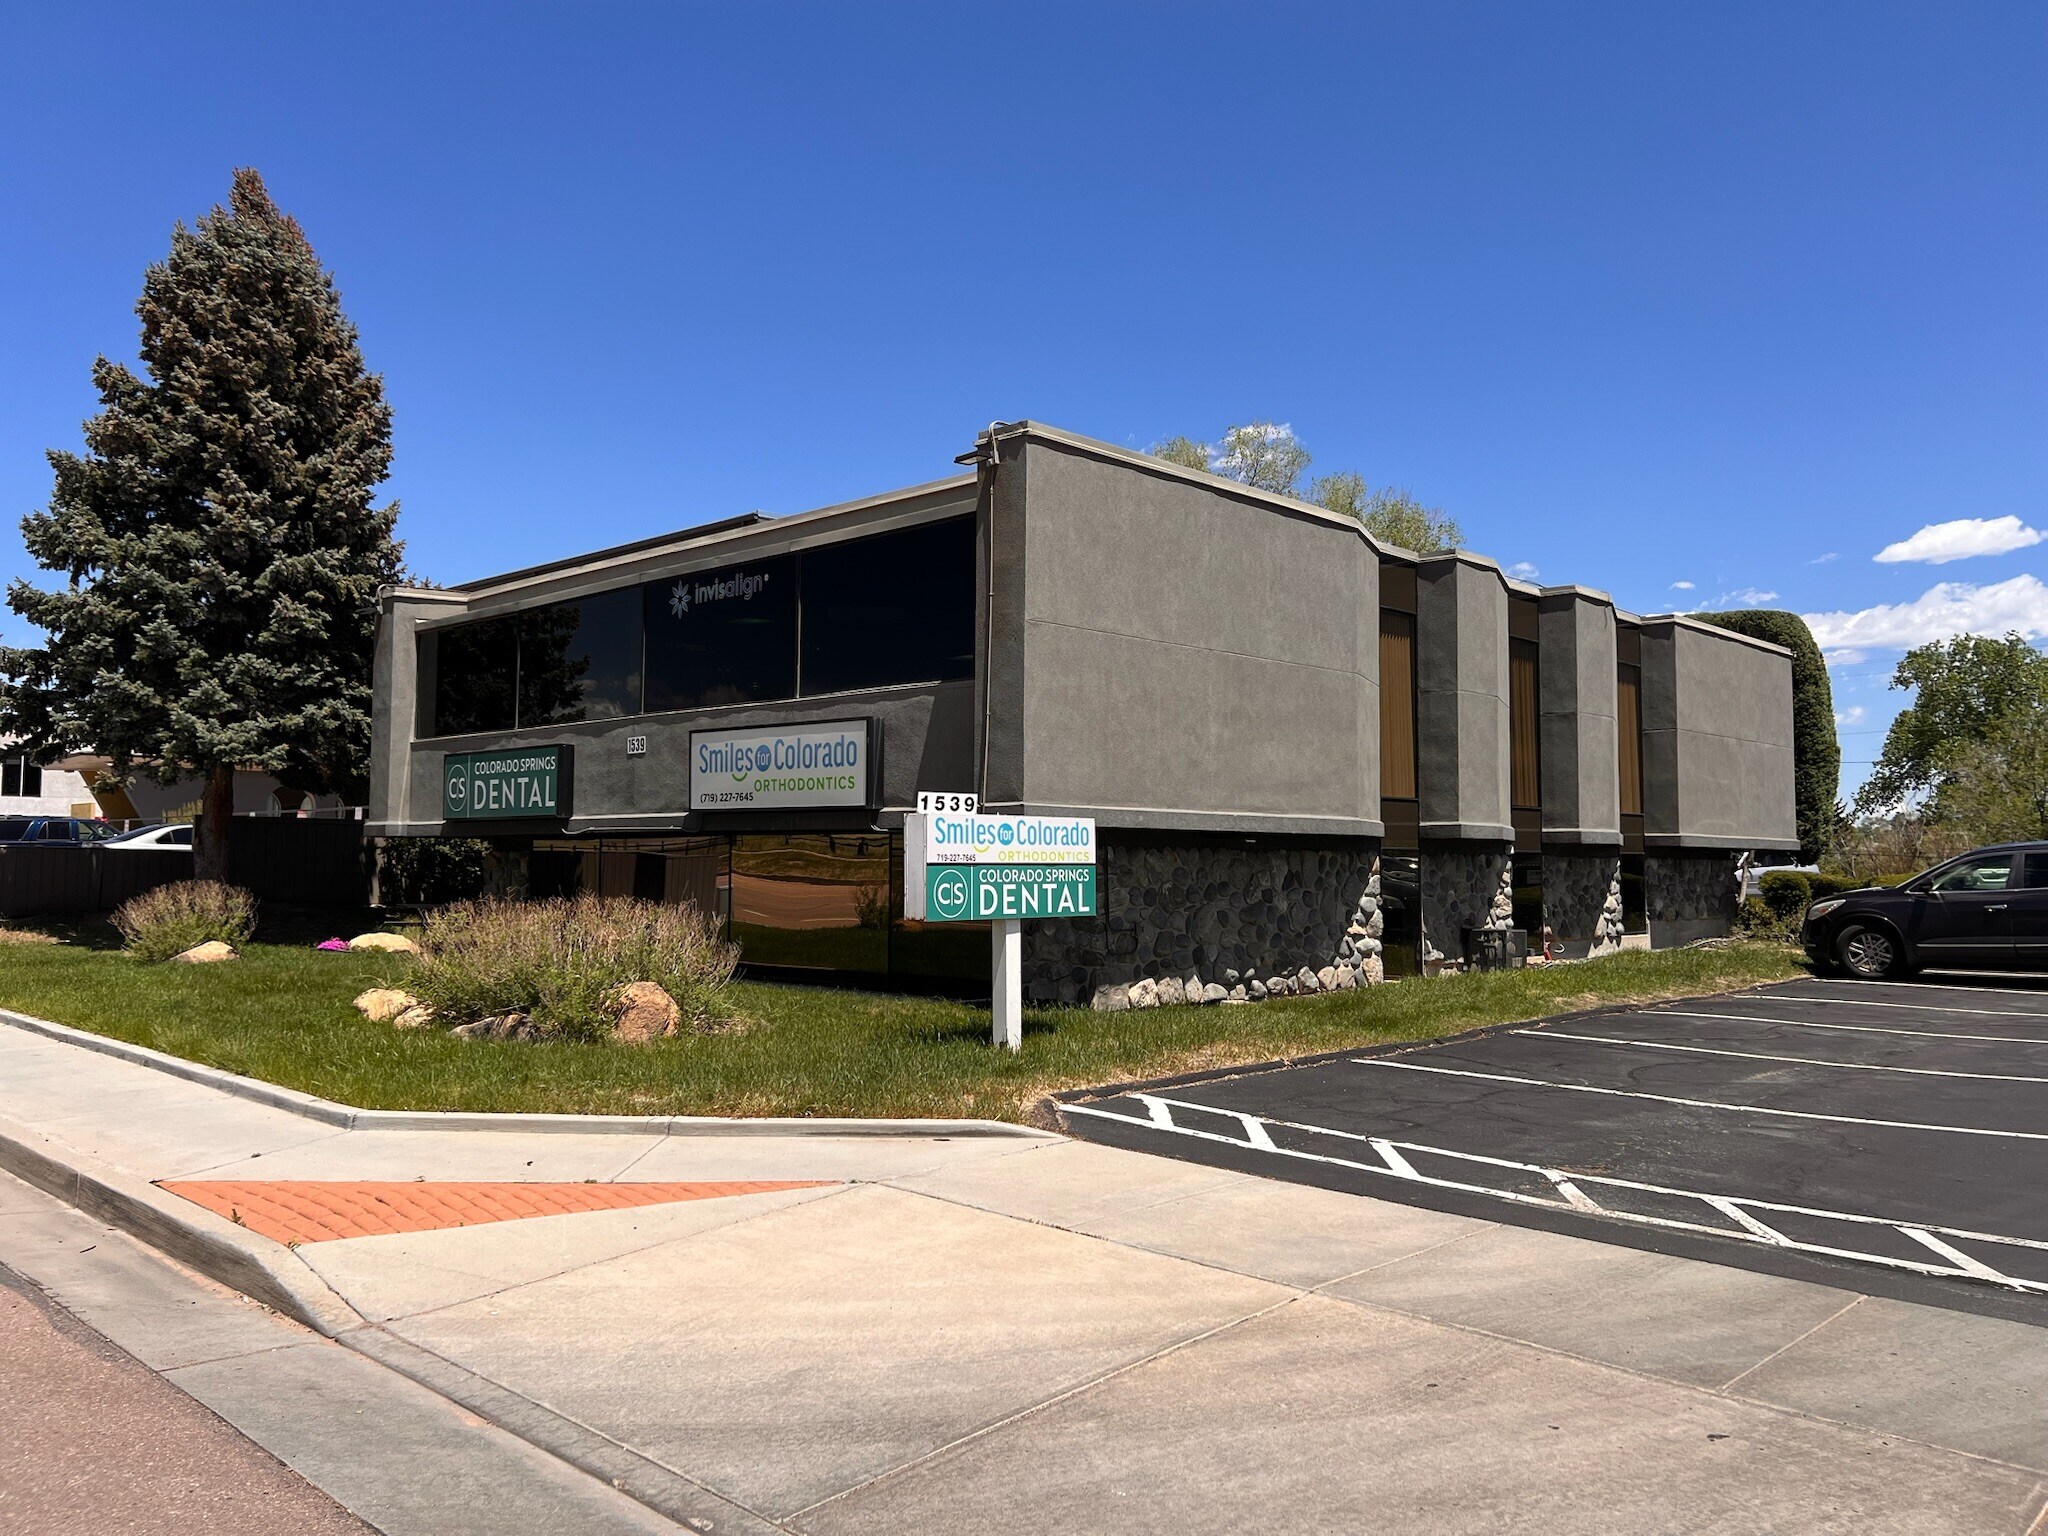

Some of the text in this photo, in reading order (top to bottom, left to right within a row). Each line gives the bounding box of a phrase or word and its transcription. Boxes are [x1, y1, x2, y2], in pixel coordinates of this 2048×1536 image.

[694, 573, 763, 604] invisalign
[627, 738, 646, 752] 1539
[700, 735, 858, 774] Smiles for Colorado
[474, 756, 556, 775] COLORADO SPRINGS
[754, 776, 855, 792] ORTHODONTICS
[474, 776, 555, 810] DENTAL
[700, 793, 754, 803] (719) 227-7645
[920, 795, 975, 812] 1539
[935, 817, 1089, 846] Smiles for Colorado
[937, 854, 976, 862] 719-227-7645
[998, 851, 1090, 862] ORTHODONTICS
[979, 869, 1090, 882] COLORADO SPRINGS
[979, 883, 1090, 916] DENTAL
